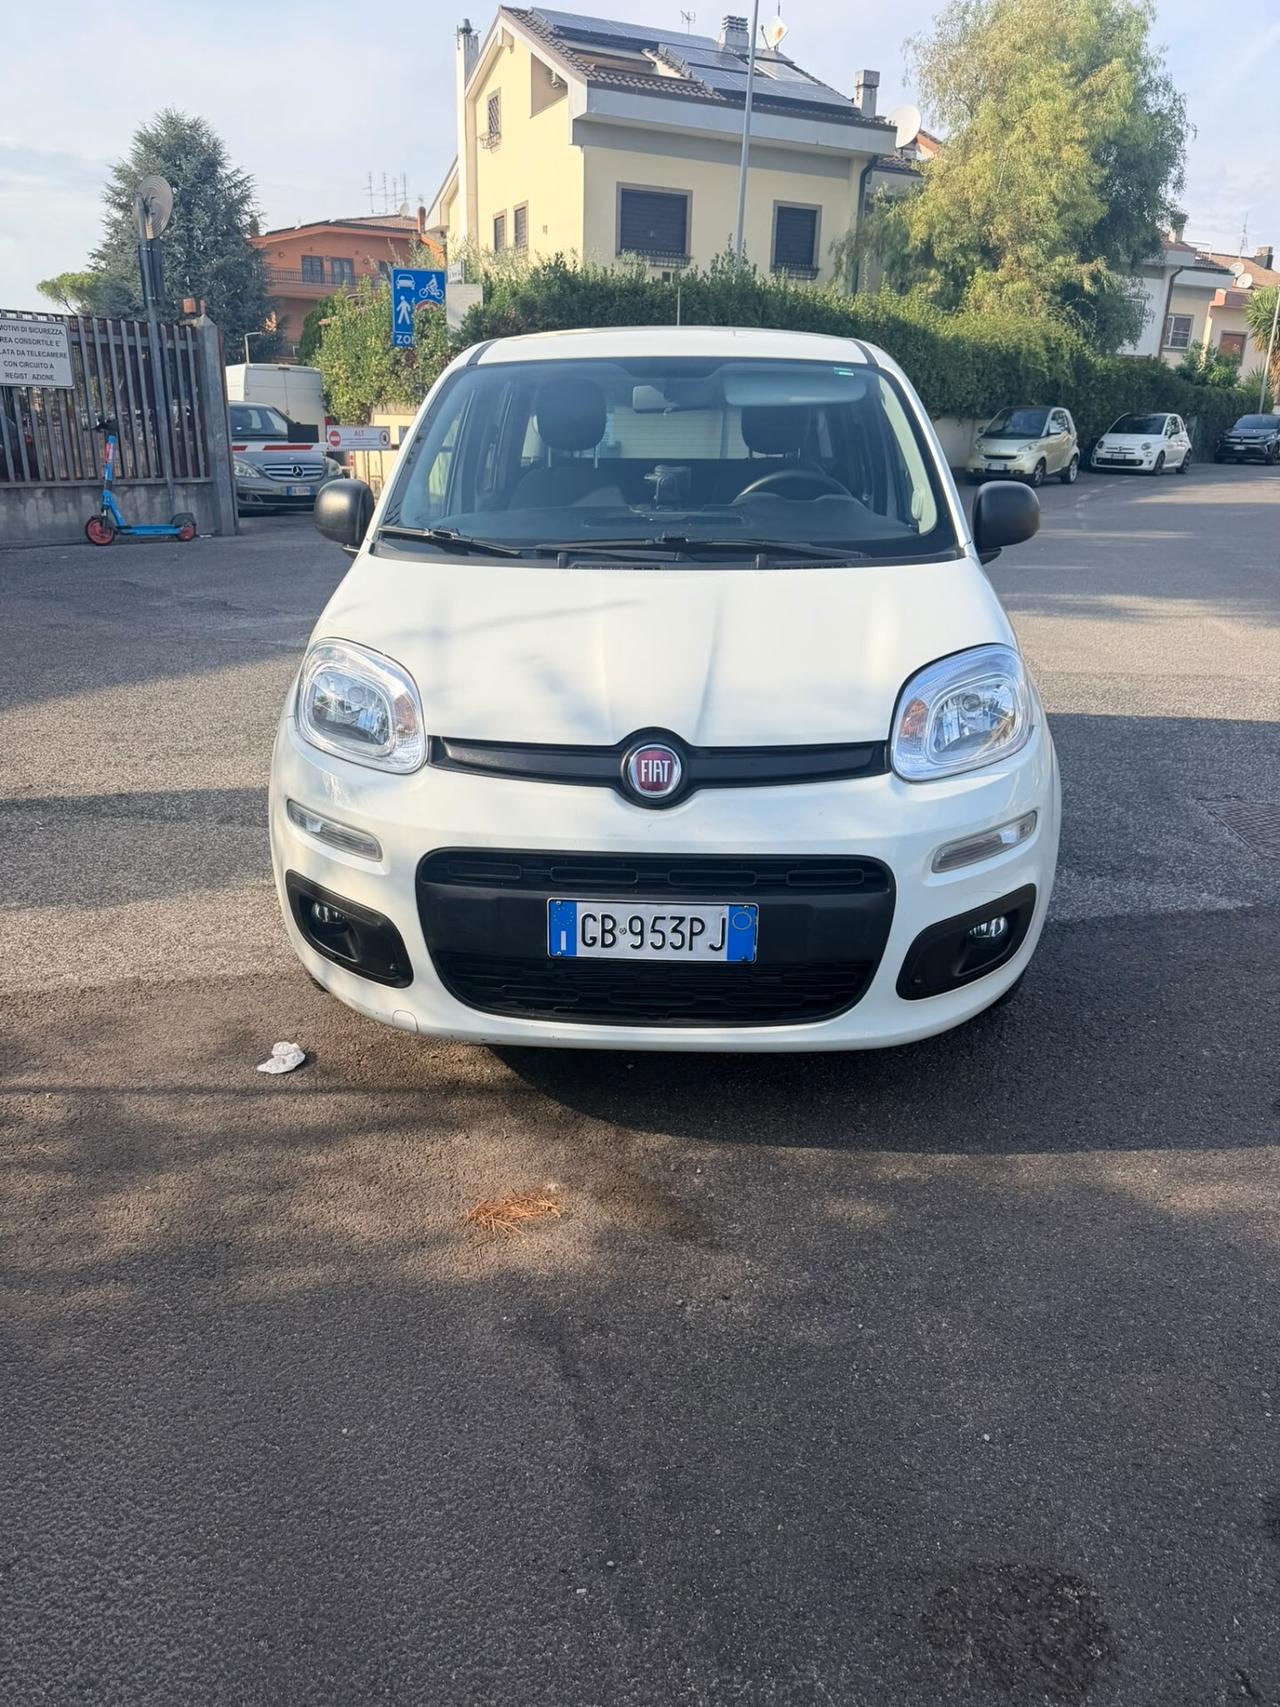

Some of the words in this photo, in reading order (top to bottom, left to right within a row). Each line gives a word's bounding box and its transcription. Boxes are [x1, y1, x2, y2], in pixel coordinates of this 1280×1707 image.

[14, 337, 54, 346] CONSORTILE
[396, 334, 414, 345] ZO
[26, 350, 68, 359] TELECAMERE
[18, 361, 49, 369] CIRCUITO
[640, 759, 671, 783] FIAT
